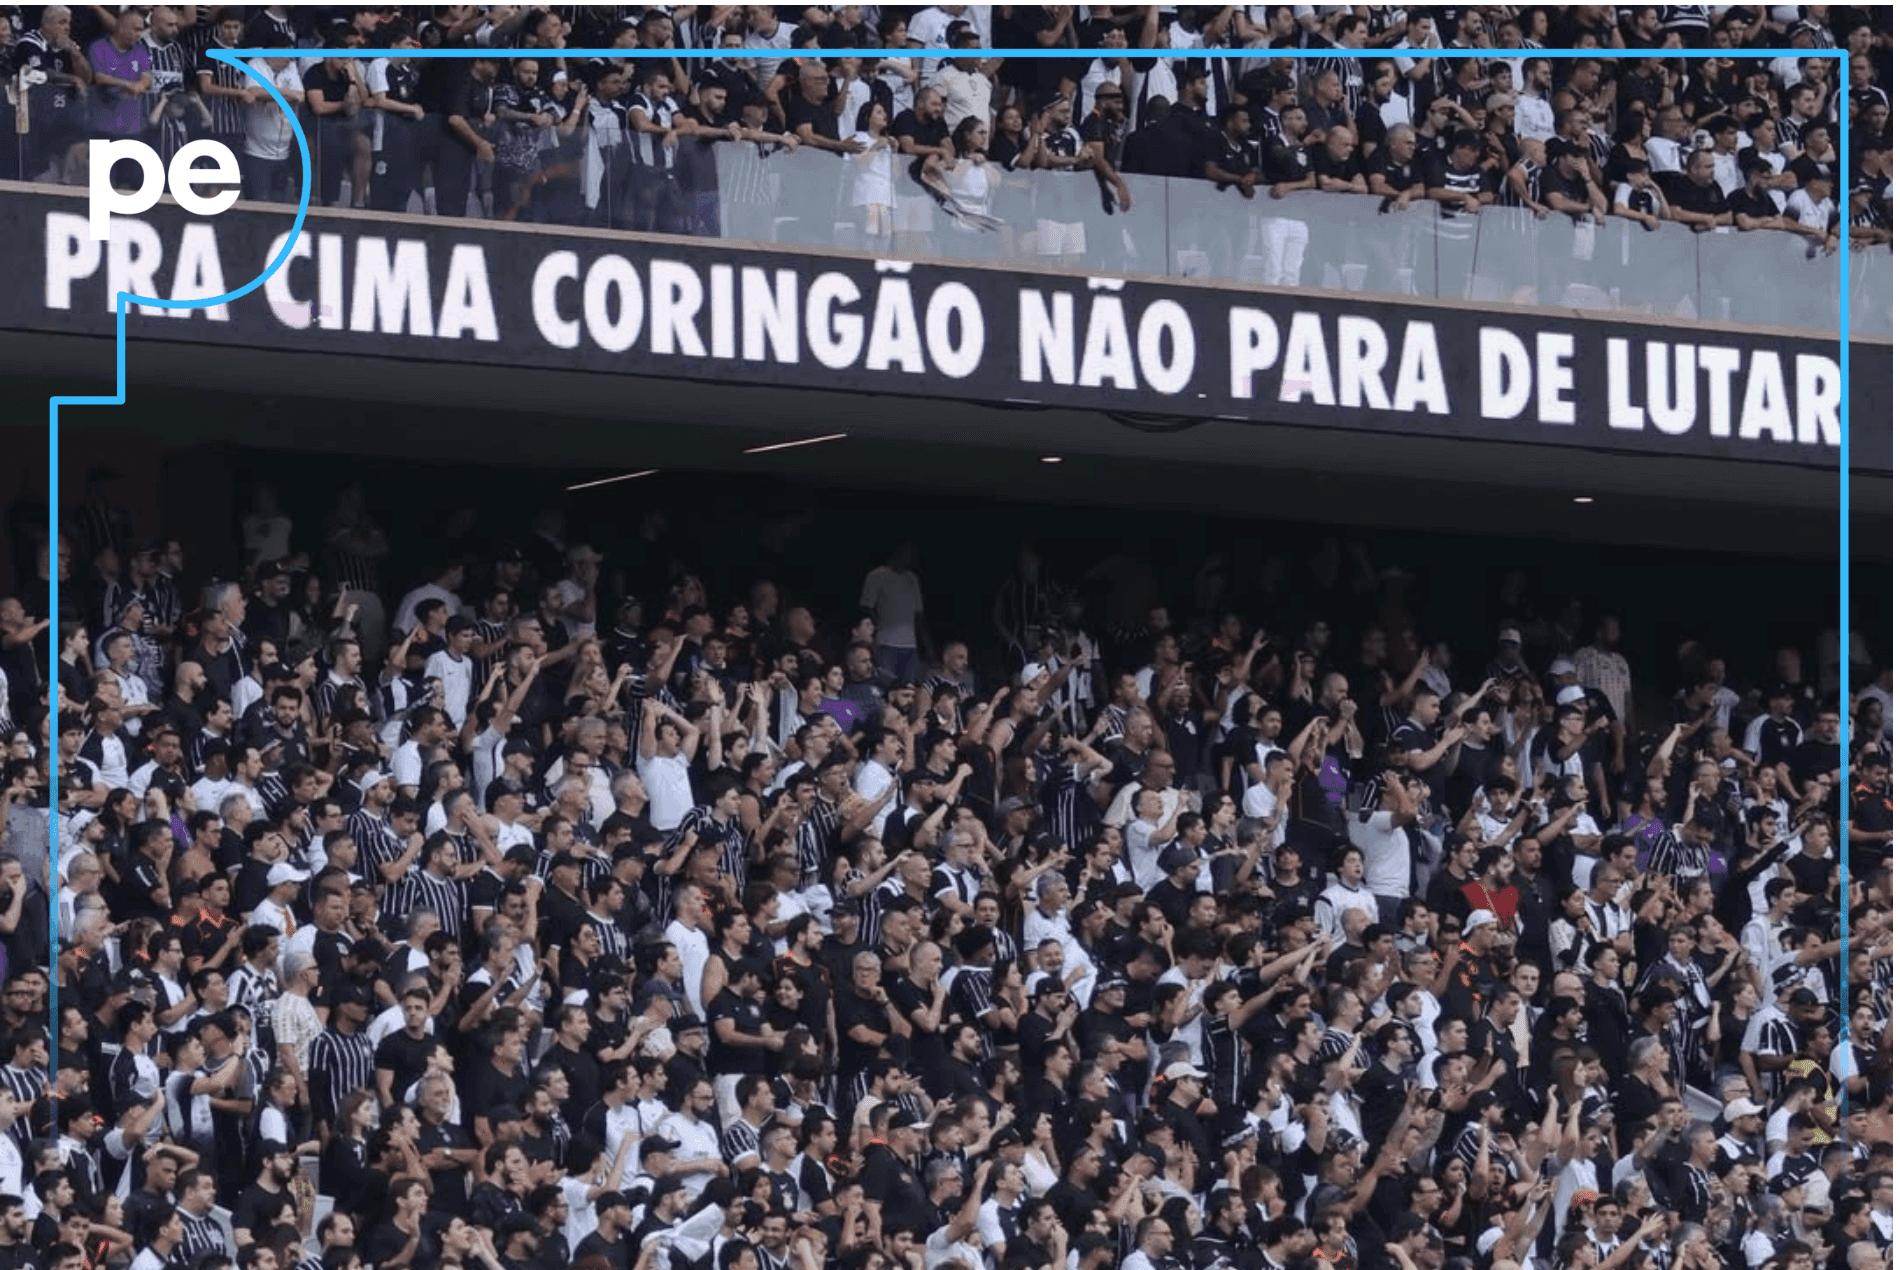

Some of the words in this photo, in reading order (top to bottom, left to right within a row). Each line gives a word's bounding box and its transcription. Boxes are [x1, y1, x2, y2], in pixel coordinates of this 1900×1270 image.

[45, 211, 231, 322] PRA
[263, 229, 499, 341] CIMA
[531, 249, 985, 379] CORINGÃO
[1019, 276, 1196, 395] NÃO
[1229, 306, 1451, 415] PARA
[1479, 326, 1576, 426] DE
[1606, 337, 1842, 447] LUTAR
